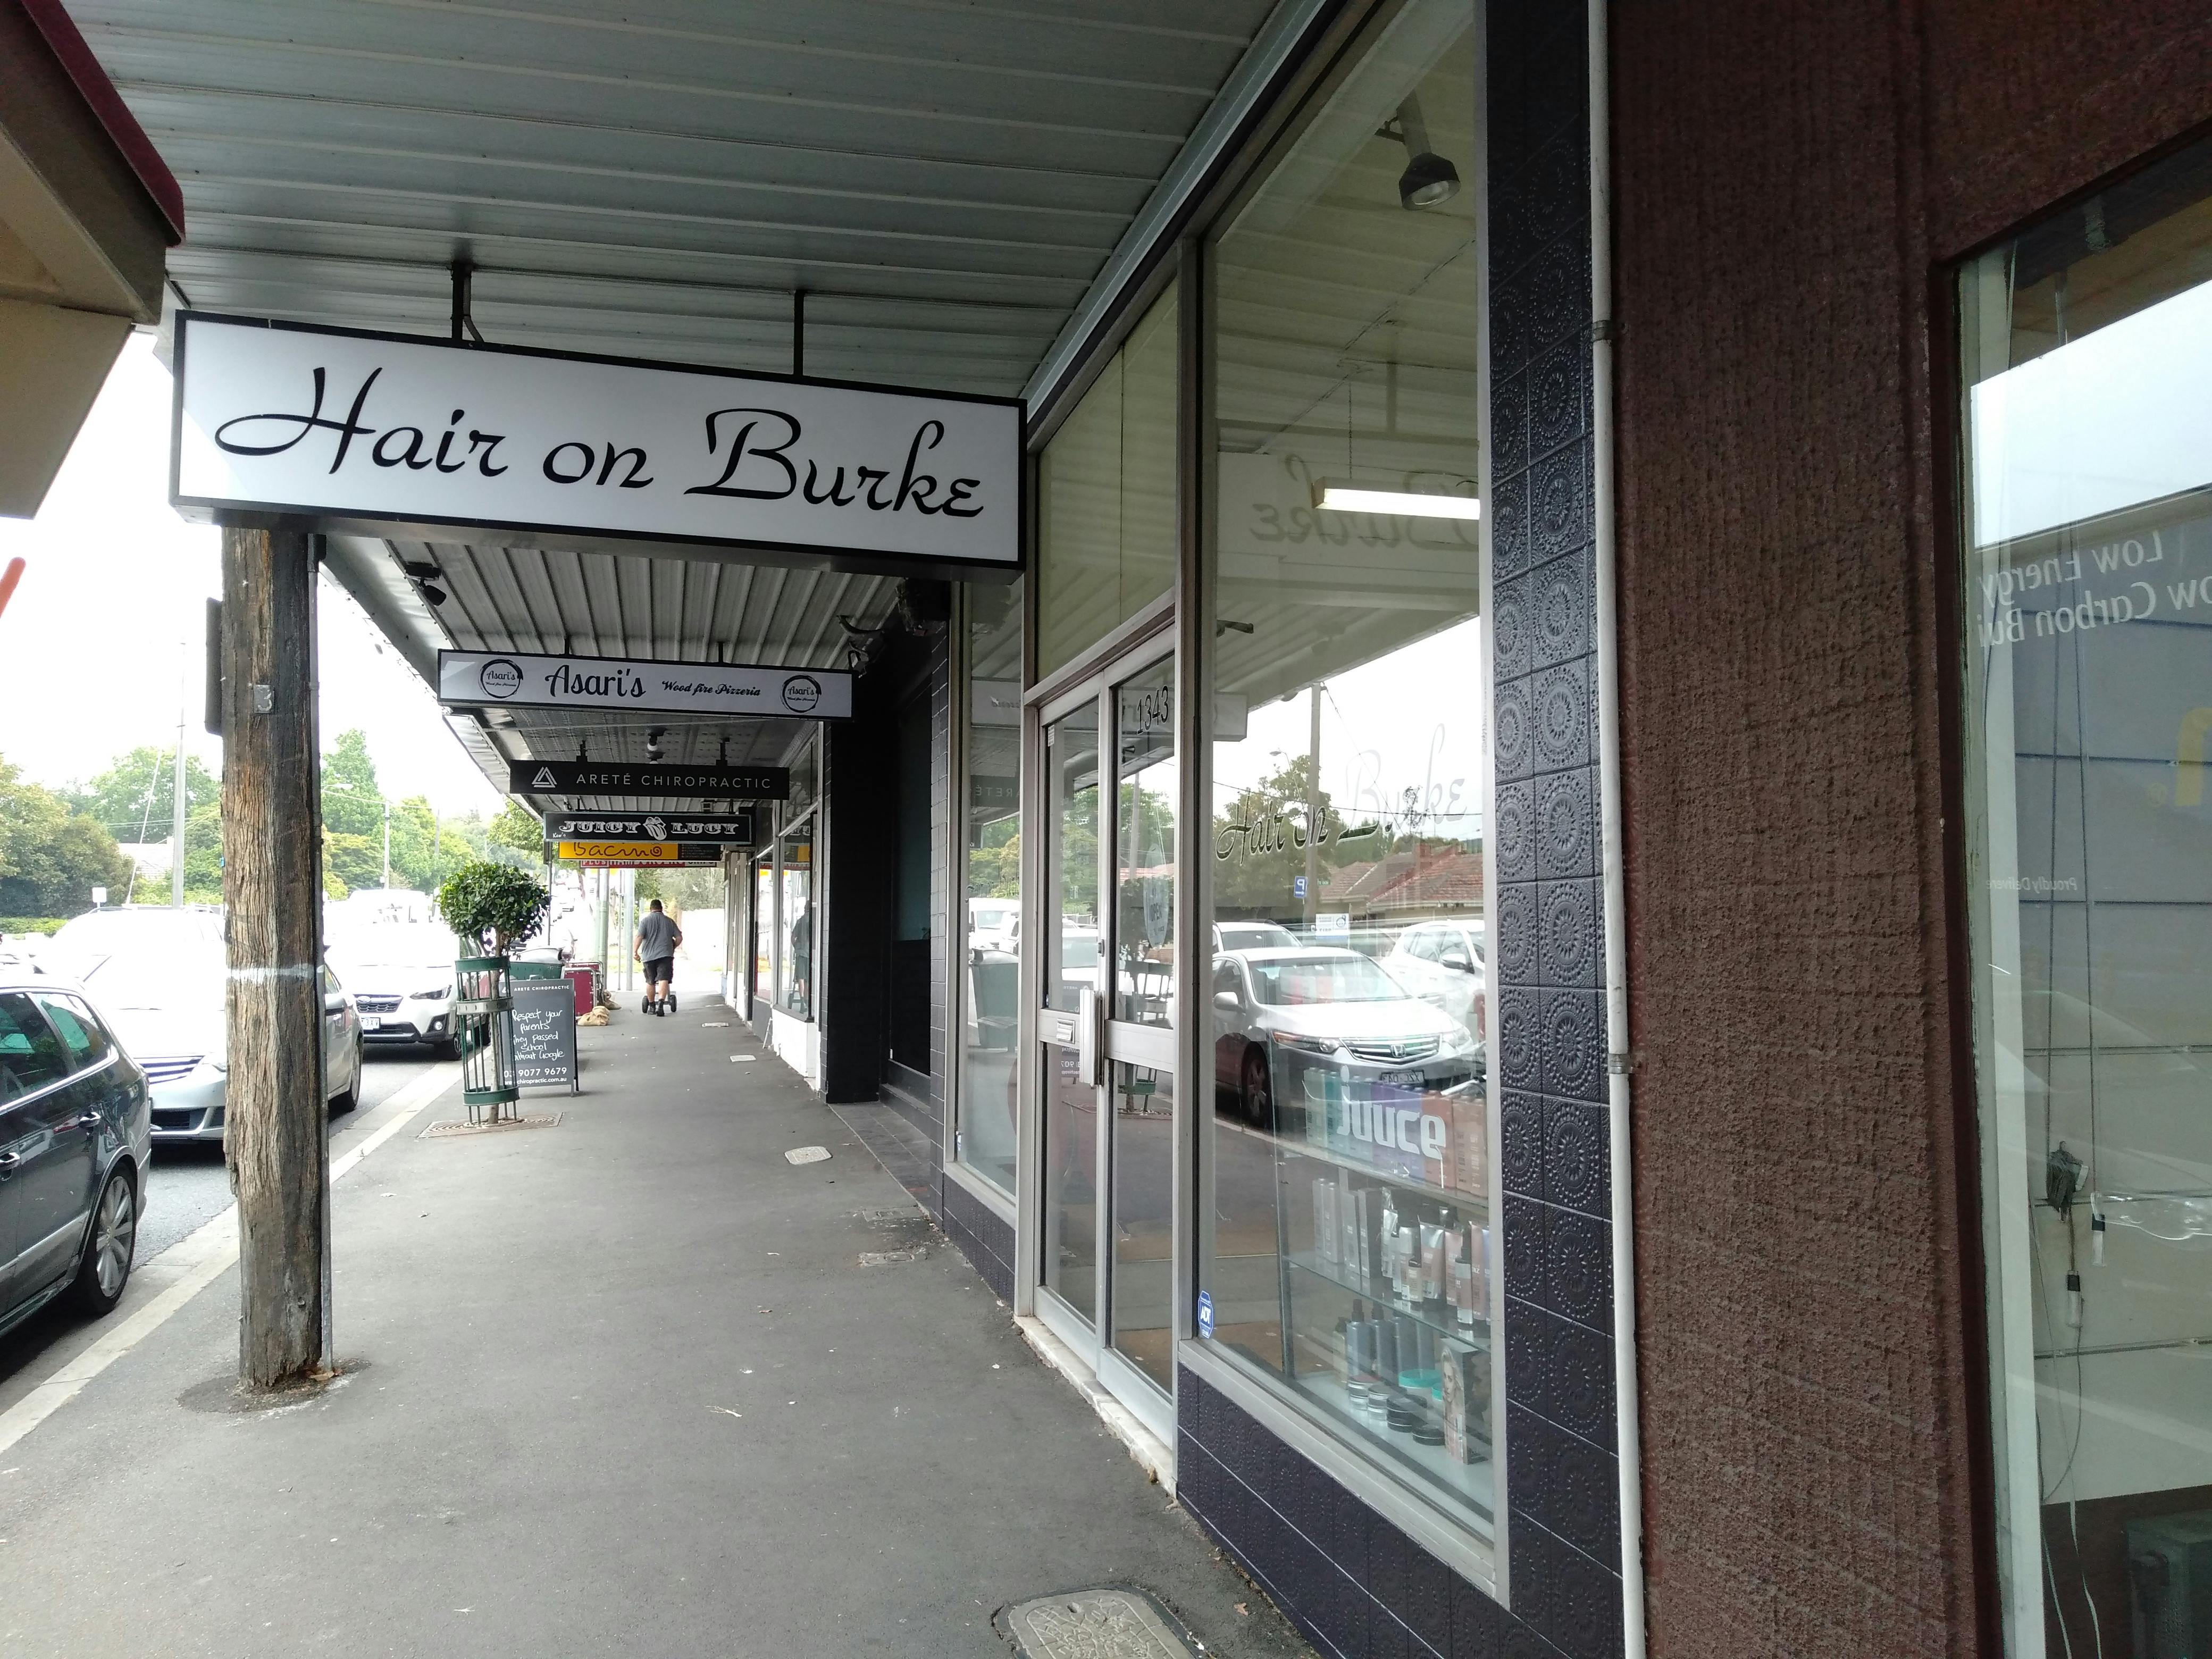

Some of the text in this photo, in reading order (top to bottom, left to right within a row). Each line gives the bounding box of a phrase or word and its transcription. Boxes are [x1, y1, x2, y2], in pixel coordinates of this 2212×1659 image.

[214, 366, 985, 518] Hair on Burke
[487, 671, 516, 680] Asari's
[544, 665, 647, 698] Asari's
[661, 681, 761, 697] Wood fire Pizzeria
[787, 685, 815, 696] Asari's
[1137, 684, 1168, 735] 1343
[576, 773, 770, 789] ARETÉ CHIROPRACTIC
[559, 820, 739, 835] JUICY LUCY
[1216, 786, 1286, 867] Hair
[1293, 804, 1329, 850] on
[512, 1008, 563, 1023] Respect your
[532, 1030, 558, 1043] passed
[539, 1049, 565, 1061] Google
[1336, 1065, 1446, 1160] juuce
[1200, 1305, 1211, 1324] ADT
